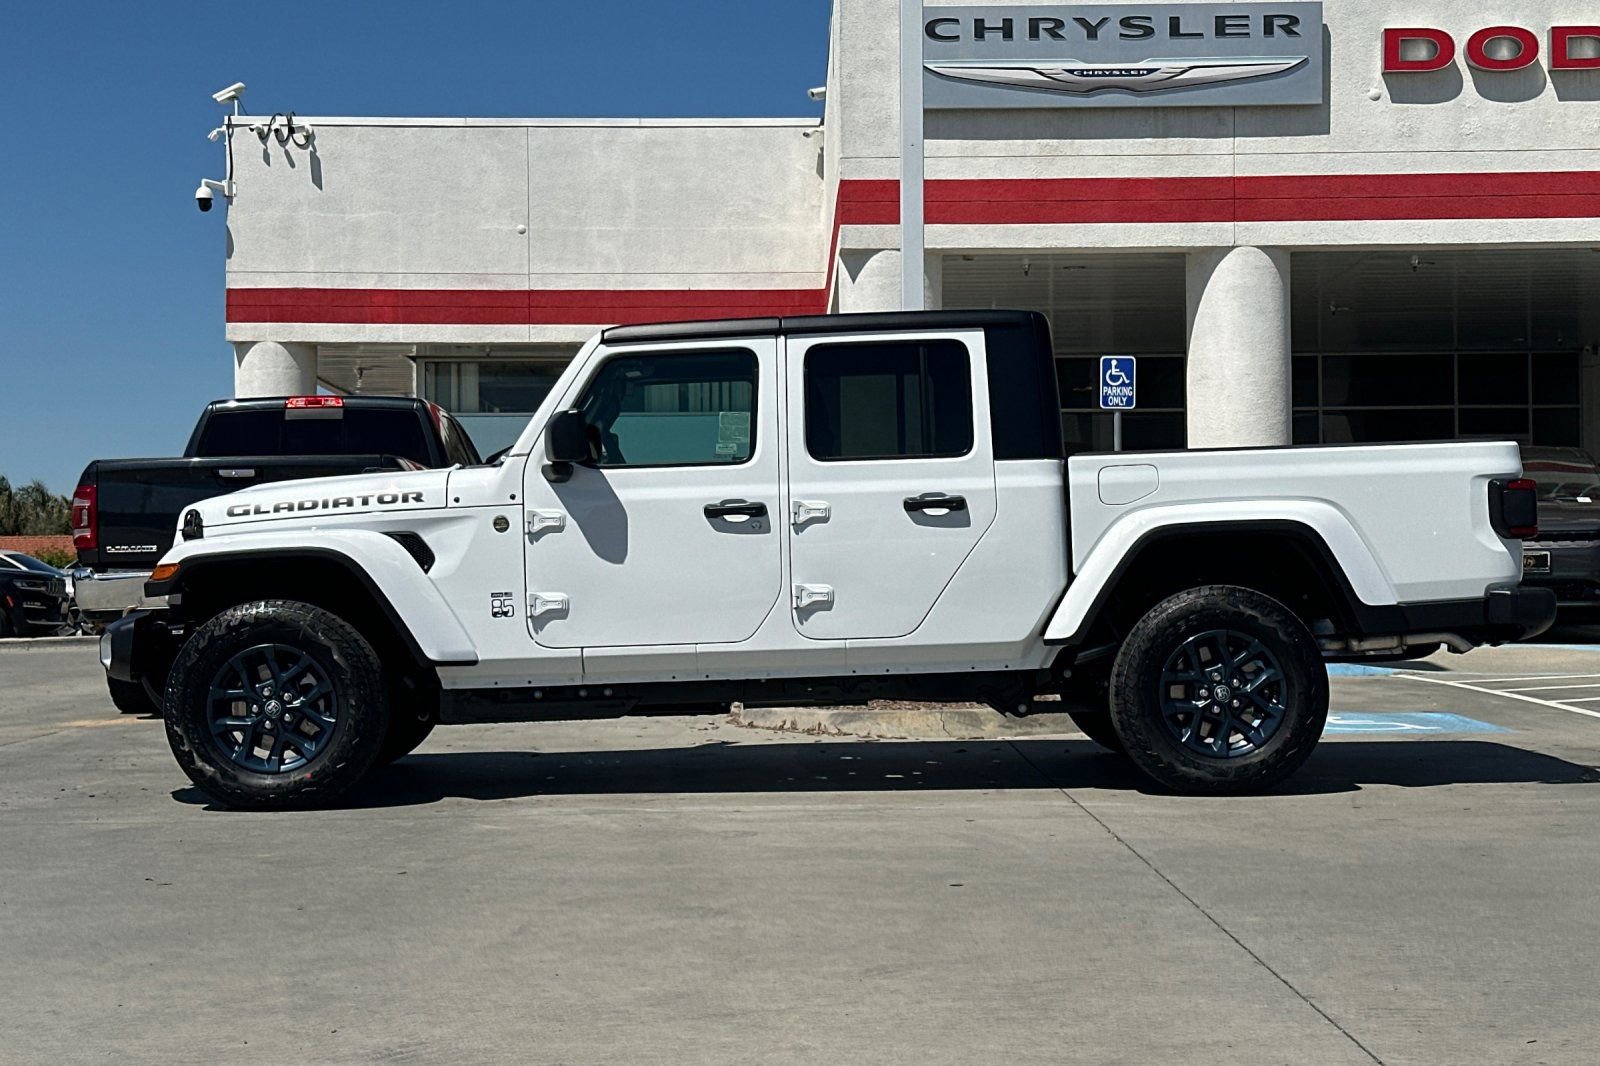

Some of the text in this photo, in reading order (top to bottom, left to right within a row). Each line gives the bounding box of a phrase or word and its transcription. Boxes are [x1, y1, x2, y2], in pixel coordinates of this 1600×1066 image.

[924, 14, 1303, 42] CHRYSLER
[1103, 386, 1133, 396] PARKING
[1108, 396, 1128, 406] ONLY
[226, 491, 424, 518] GLADIATOR
